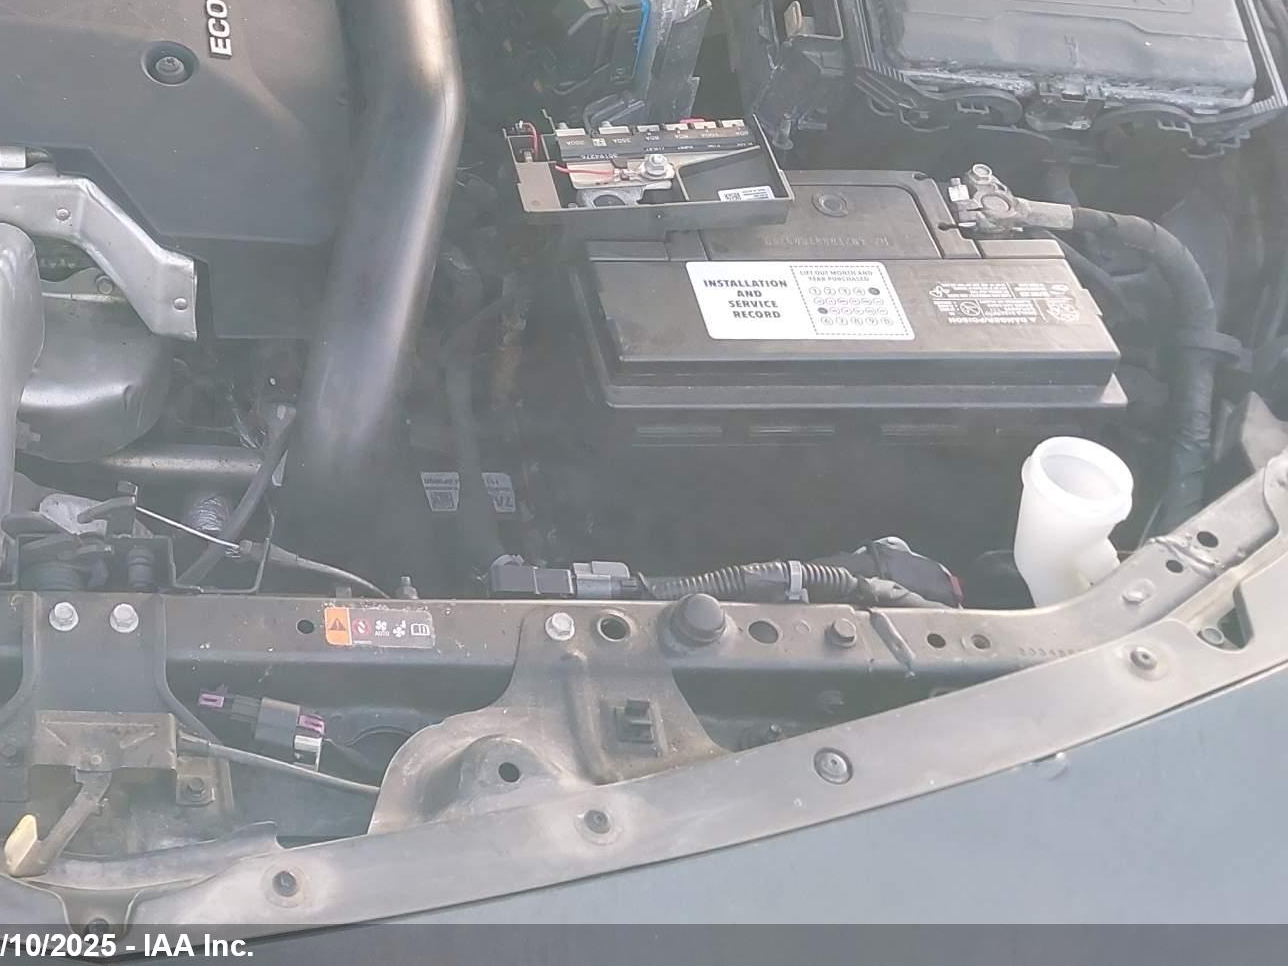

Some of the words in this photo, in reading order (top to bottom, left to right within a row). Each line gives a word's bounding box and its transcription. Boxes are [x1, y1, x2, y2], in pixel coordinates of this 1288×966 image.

[703, 279, 788, 288] INSTALLATION
[728, 300, 779, 308] SERVICE
[732, 310, 781, 319] RECORD
